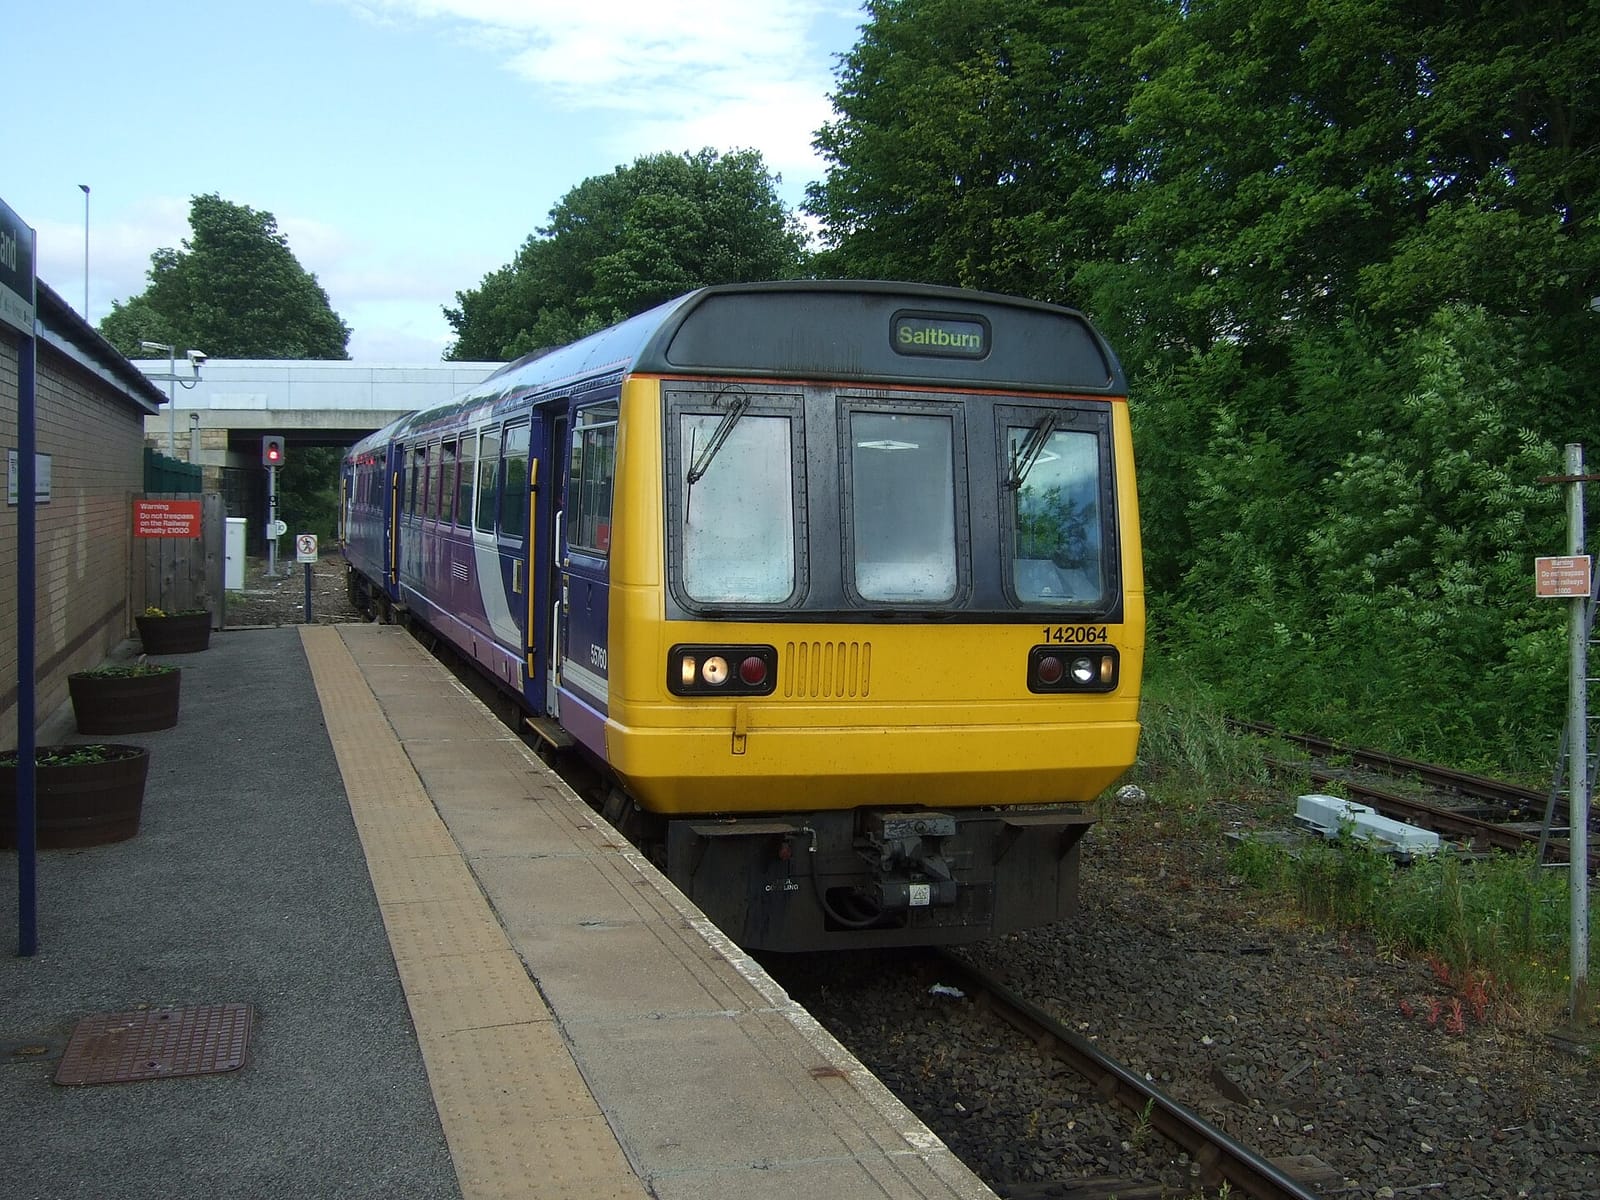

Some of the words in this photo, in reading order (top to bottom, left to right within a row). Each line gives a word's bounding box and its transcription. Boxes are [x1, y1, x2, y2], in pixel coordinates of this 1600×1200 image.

[899, 326, 981, 348] Saltburn
[140, 503, 169, 511] Warning
[163, 520, 190, 528] Railway
[140, 527, 166, 535] Penalty
[1043, 626, 1108, 643] 142064
